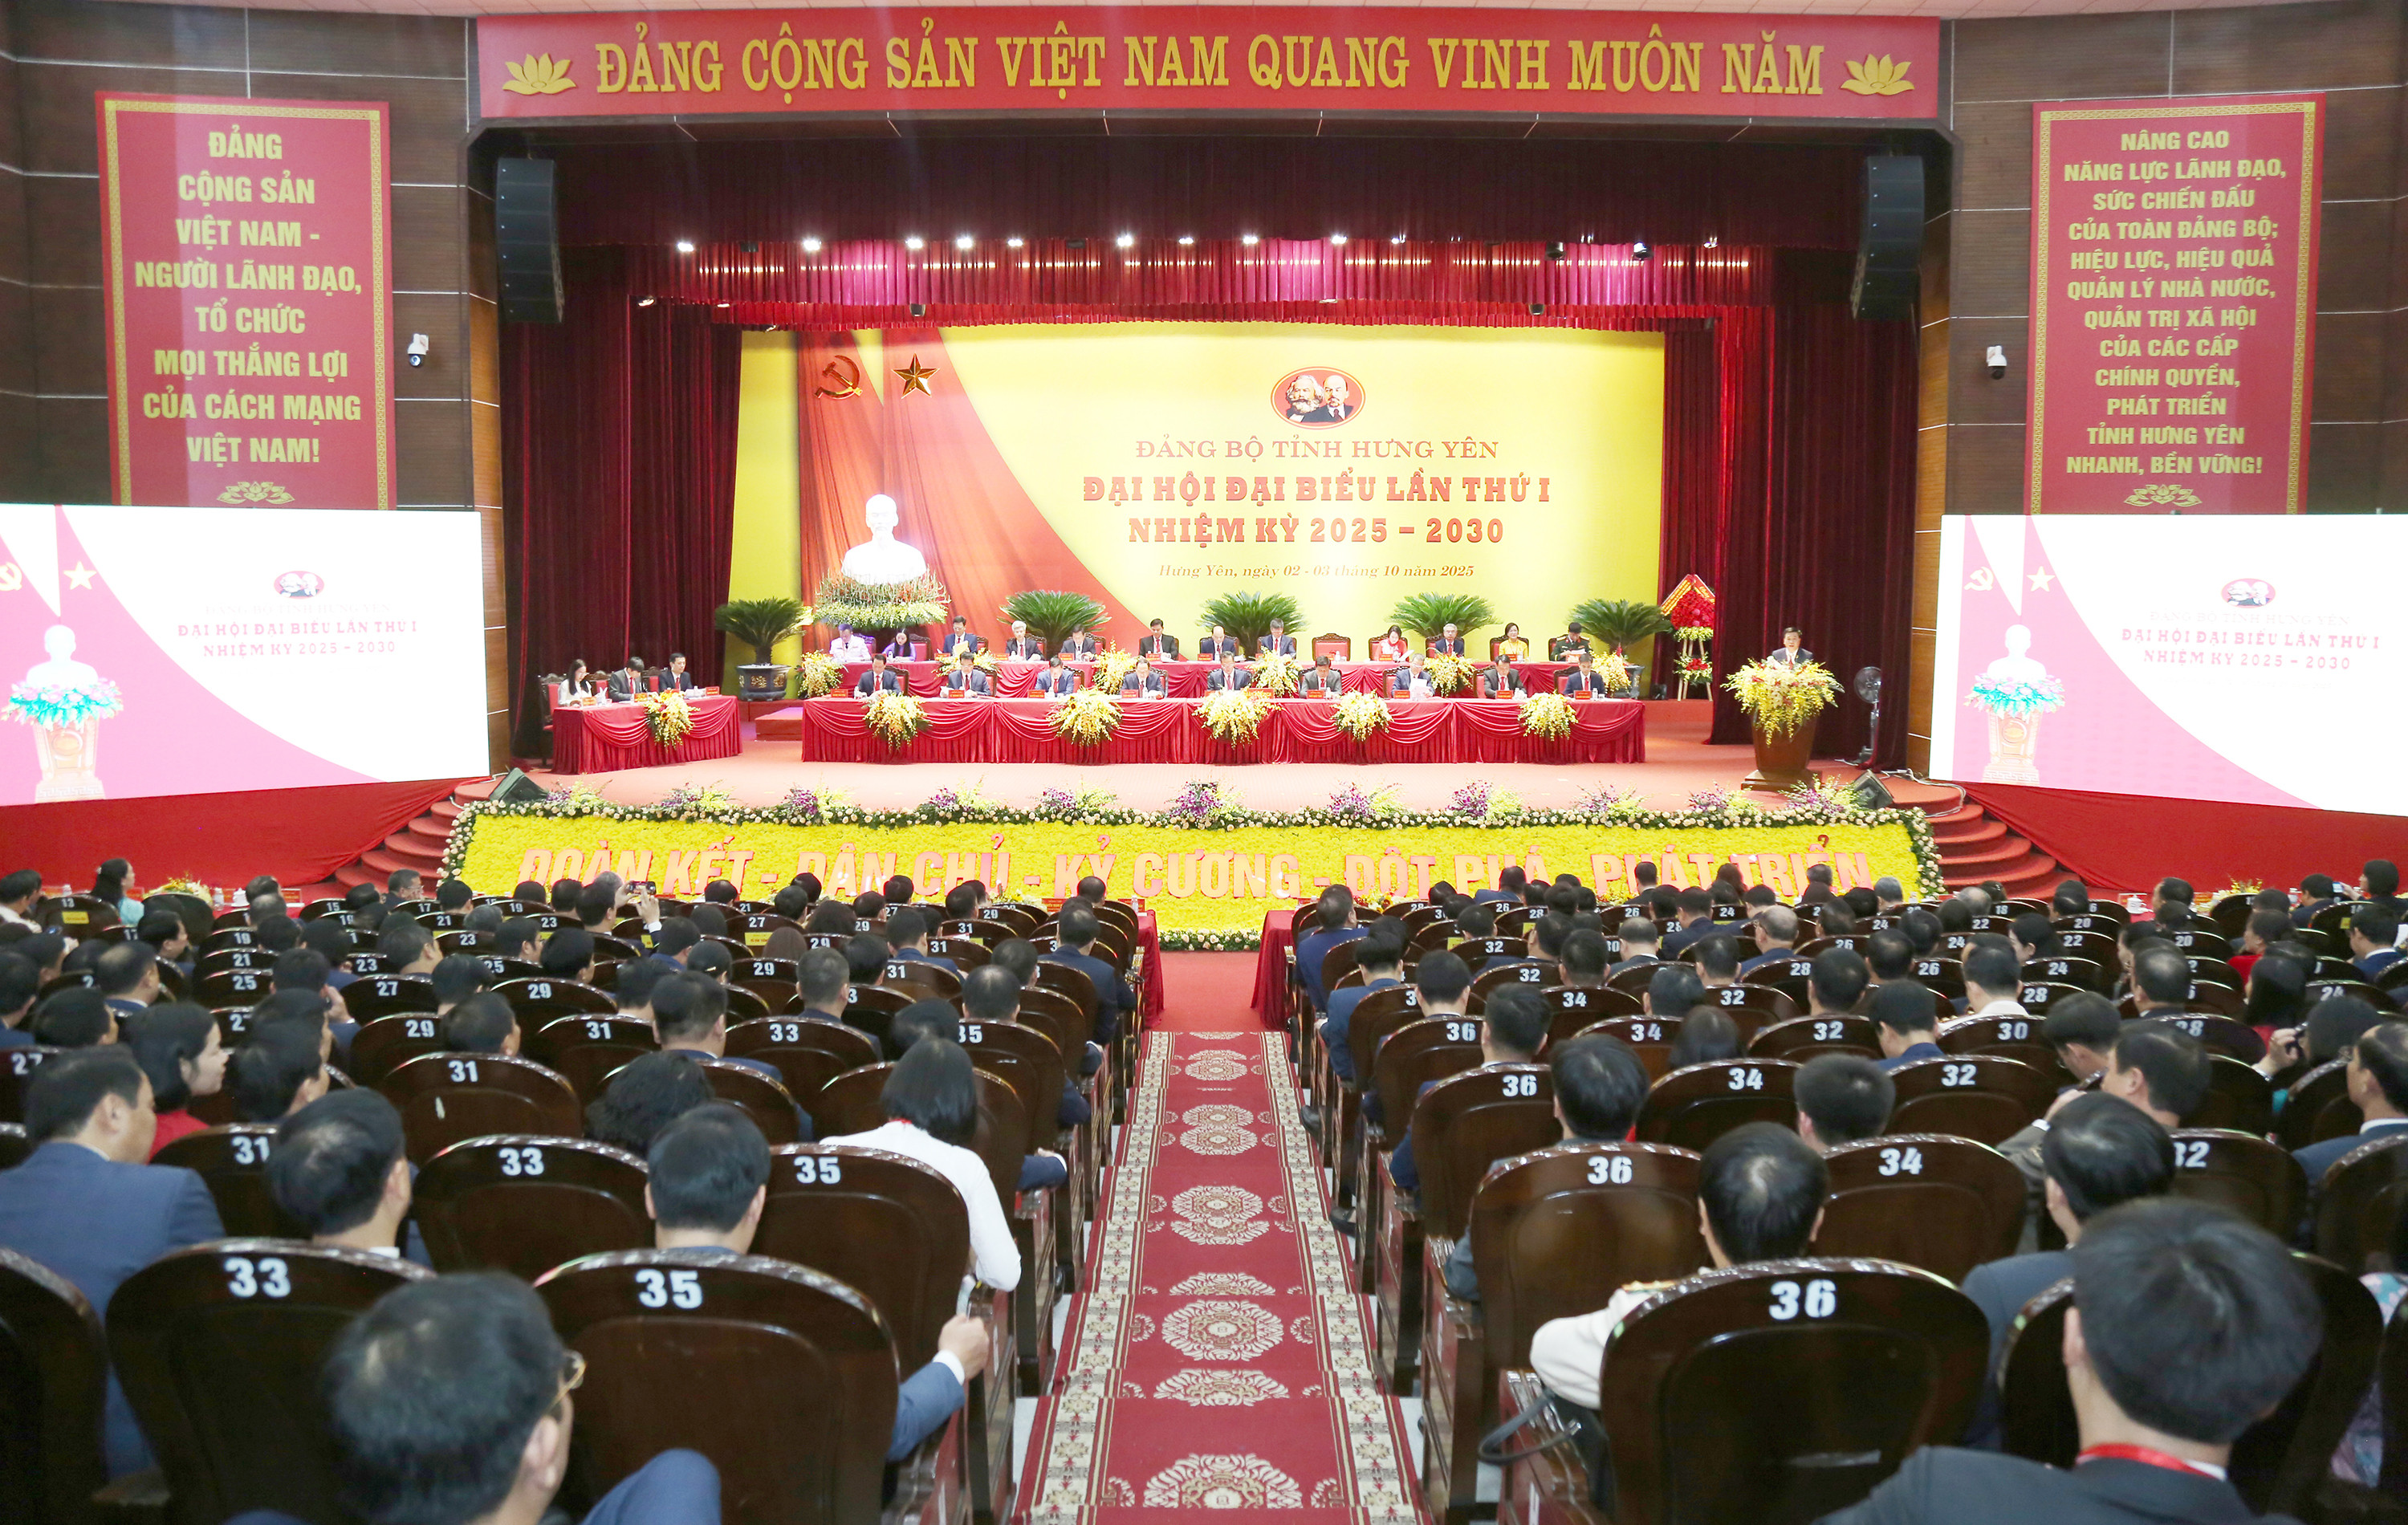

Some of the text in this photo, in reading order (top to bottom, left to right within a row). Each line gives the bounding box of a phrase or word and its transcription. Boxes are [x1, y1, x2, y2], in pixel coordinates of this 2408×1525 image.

[596, 18, 1824, 104] ĐẢNG CỘNG SẢN VIỆT NAM QUANG VINH MUÔN NĂM
[208, 124, 282, 159] ĐẢNG
[2121, 129, 2229, 150] NÂNG CAO
[2064, 158, 2286, 183] NĂNG LỰC LÃNH ĐẠO,
[179, 170, 315, 206] CỘNG SẢN
[2093, 186, 2255, 210] SỨC CHIẾN ĐẤU
[176, 214, 231, 250] VIỆT
[240, 221, 301, 246] NAM
[2069, 215, 2278, 240] CỦA TOÀN ĐẢNG BỘ;
[2072, 243, 2274, 272] HIỆU LỰC, HIỆU QUẢ
[136, 258, 361, 296] NGƯỜI LÃNH ĐẠO,
[2068, 276, 2275, 300] QUẢN LÝ NHÀ NƯỚC,
[195, 297, 305, 333] TỔ CHỨC
[2085, 305, 2256, 331] QUẢN TRỊ XÃ HỘI
[2100, 333, 2238, 356] CỦA CÁC CẤP
[155, 342, 347, 382] MỌI THẮNG LỢI
[2096, 363, 2239, 388] CHÍNH QUYỀN,
[144, 385, 360, 425] CỦA CÁCH MẠNG
[2108, 392, 2226, 415] PHÁT TRIỂN
[2087, 422, 2244, 444] TỈNH HƯNG YÊN
[186, 432, 319, 467] VIỆT NAM!
[1137, 434, 1498, 462] ĐẢNG BỘ TỈNH HƯNG YÊN
[2067, 451, 2262, 475] NHANH, BỀN VỮNG!
[1084, 467, 1549, 506] ĐẠI HỘI ĐẠI BIỂU LẦN THỨ I
[1129, 513, 1244, 548] NHIỆM
[1255, 513, 1299, 542] KỲ
[1311, 518, 1387, 543] 2025
[1426, 518, 1503, 543] 2030
[1160, 565, 1201, 578] Hưng
[1207, 565, 1237, 577] Yên,
[1243, 565, 1279, 579] ngày
[1385, 566, 1399, 575] 10
[1404, 564, 1437, 576] năm
[1441, 566, 1474, 575] 2025
[663, 836, 754, 901] KẾT
[797, 843, 896, 896] DÂN
[913, 833, 1011, 896] CHỦ
[1056, 834, 1116, 897] KỶ
[1134, 849, 1300, 898] CƯƠNG
[234, 933, 250, 944] 19
[931, 941, 946, 953] 31
[1486, 941, 1503, 953] 32
[2064, 935, 2082, 946] 22
[234, 954, 250, 966] 21
[754, 962, 774, 975] 29
[888, 965, 905, 978] 31
[2048, 962, 2068, 974] 24
[233, 975, 256, 990] 25
[1520, 969, 1540, 982] 32
[376, 982, 397, 996] 27
[528, 983, 551, 998] 29
[1563, 992, 1586, 1007] 34
[1721, 990, 1744, 1005] 32
[2024, 987, 2047, 1002] 28
[406, 1020, 434, 1037] 29
[587, 1022, 611, 1039] 31
[770, 1024, 798, 1041] 33
[1446, 1023, 1475, 1041] 36
[1632, 1023, 1661, 1041] 34
[1814, 1021, 1843, 1040] 32
[1998, 1023, 2028, 1039] 30
[449, 1060, 478, 1082] 31
[1729, 1068, 1763, 1090] 34
[1942, 1064, 1976, 1086] 32
[1503, 1075, 1536, 1096] 36
[233, 1137, 269, 1164] 31
[499, 1148, 543, 1175] 33
[1879, 1148, 1922, 1176] 34
[795, 1157, 840, 1184] 35
[1588, 1157, 1632, 1184] 36
[226, 1258, 290, 1296] 33
[636, 1270, 702, 1308] 35
[1770, 1280, 1835, 1320] 36
